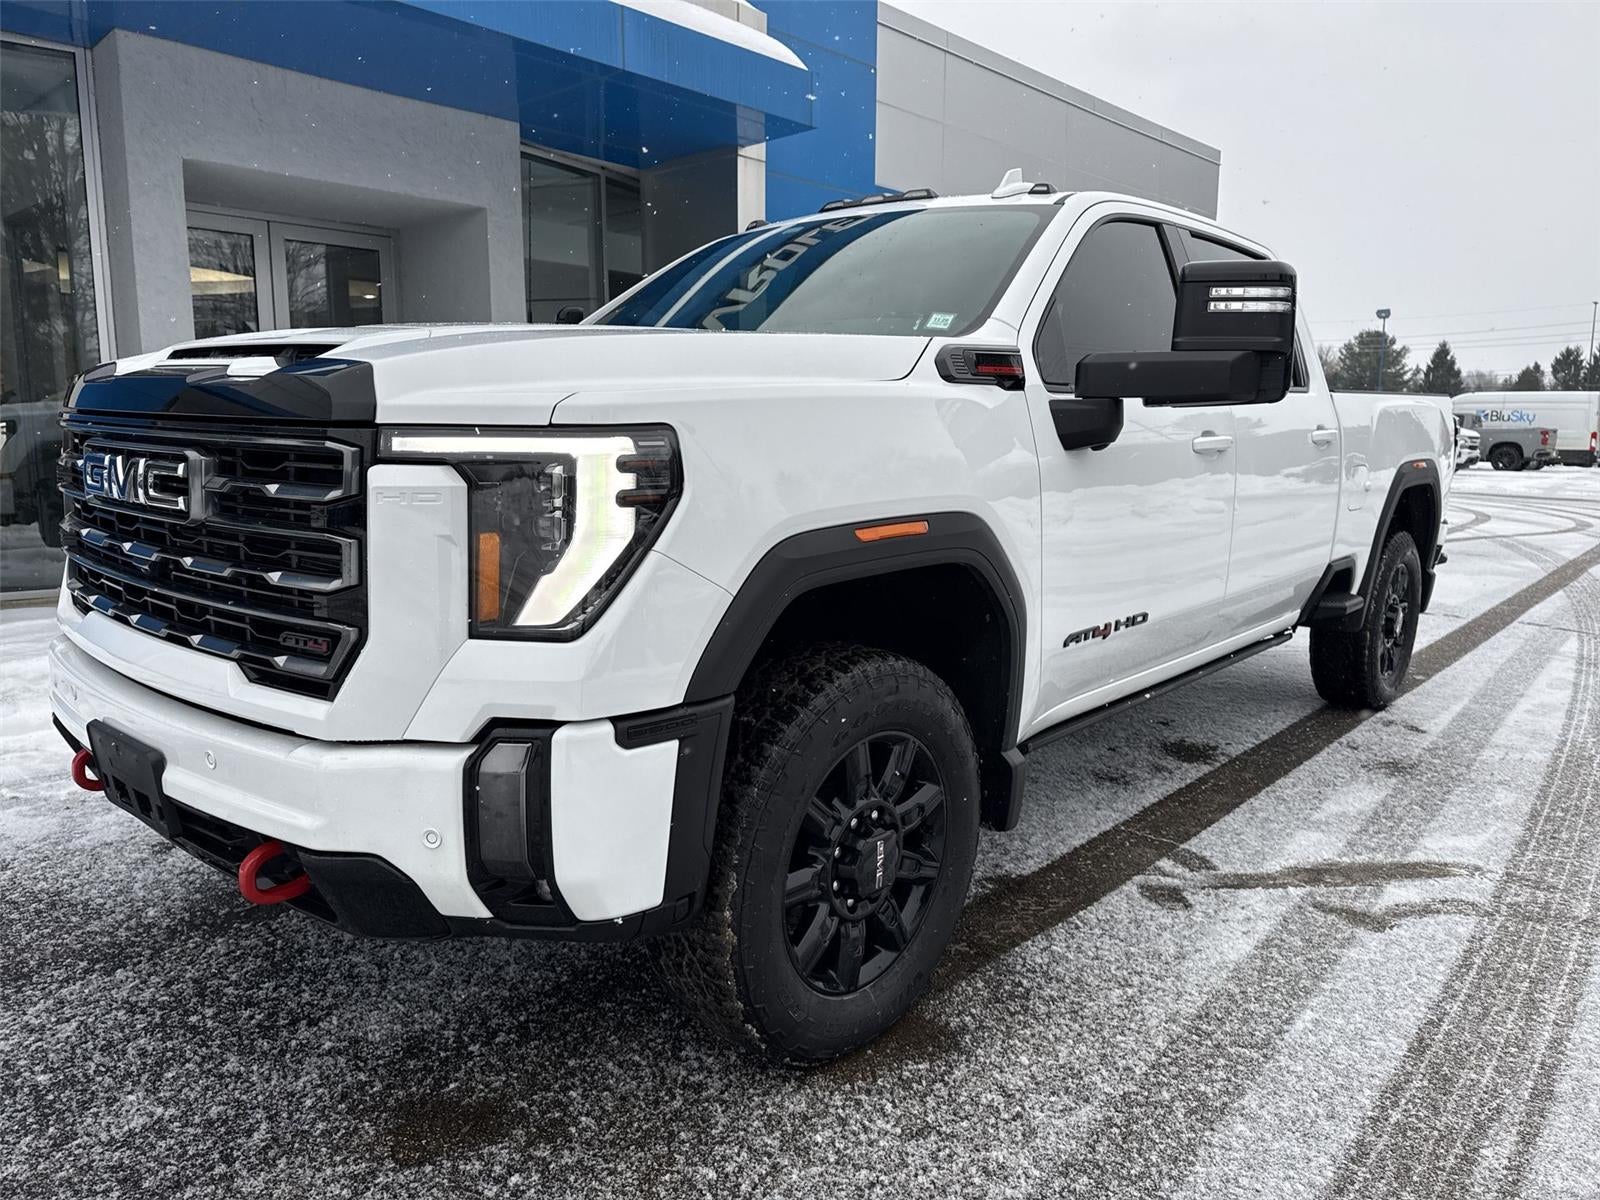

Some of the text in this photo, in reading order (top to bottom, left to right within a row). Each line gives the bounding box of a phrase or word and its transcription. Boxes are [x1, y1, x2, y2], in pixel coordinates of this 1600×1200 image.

[1489, 409, 1537, 425] BluSky
[83, 452, 189, 512] GMC
[375, 491, 444, 505] HD
[280, 631, 331, 656] AT4
[1062, 611, 1149, 649] AT4 HD
[876, 840, 885, 889] GMC
